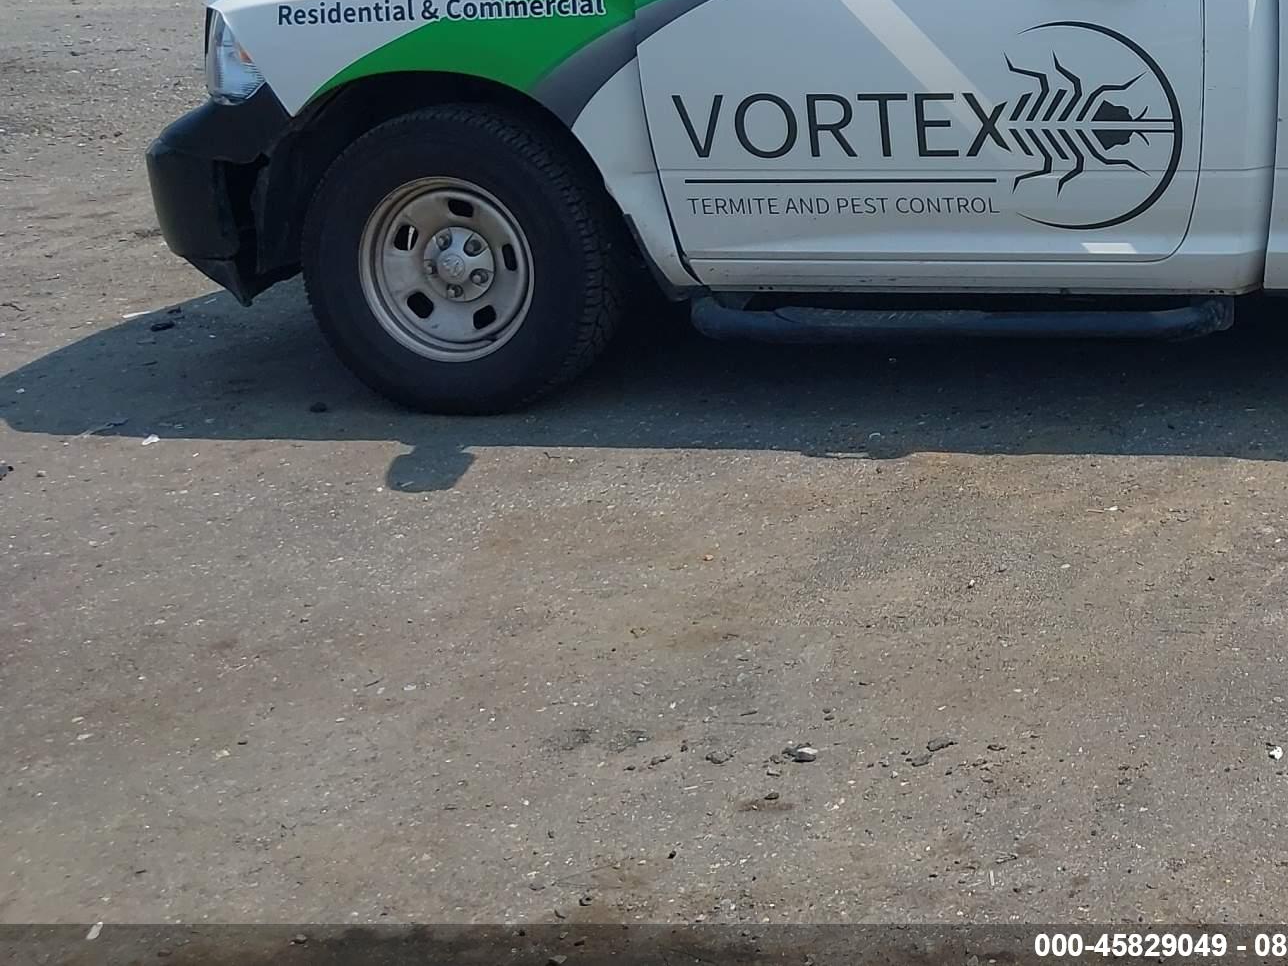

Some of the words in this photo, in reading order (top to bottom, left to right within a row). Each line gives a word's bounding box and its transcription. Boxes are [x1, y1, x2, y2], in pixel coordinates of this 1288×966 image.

[278, 0, 415, 26] Residential
[421, 0, 439, 20] &
[671, 92, 1012, 159] VORTEX
[687, 197, 781, 215] TERMITE
[785, 197, 830, 215] AND
[837, 197, 889, 215] PEST
[896, 196, 1000, 215] CONTROL
